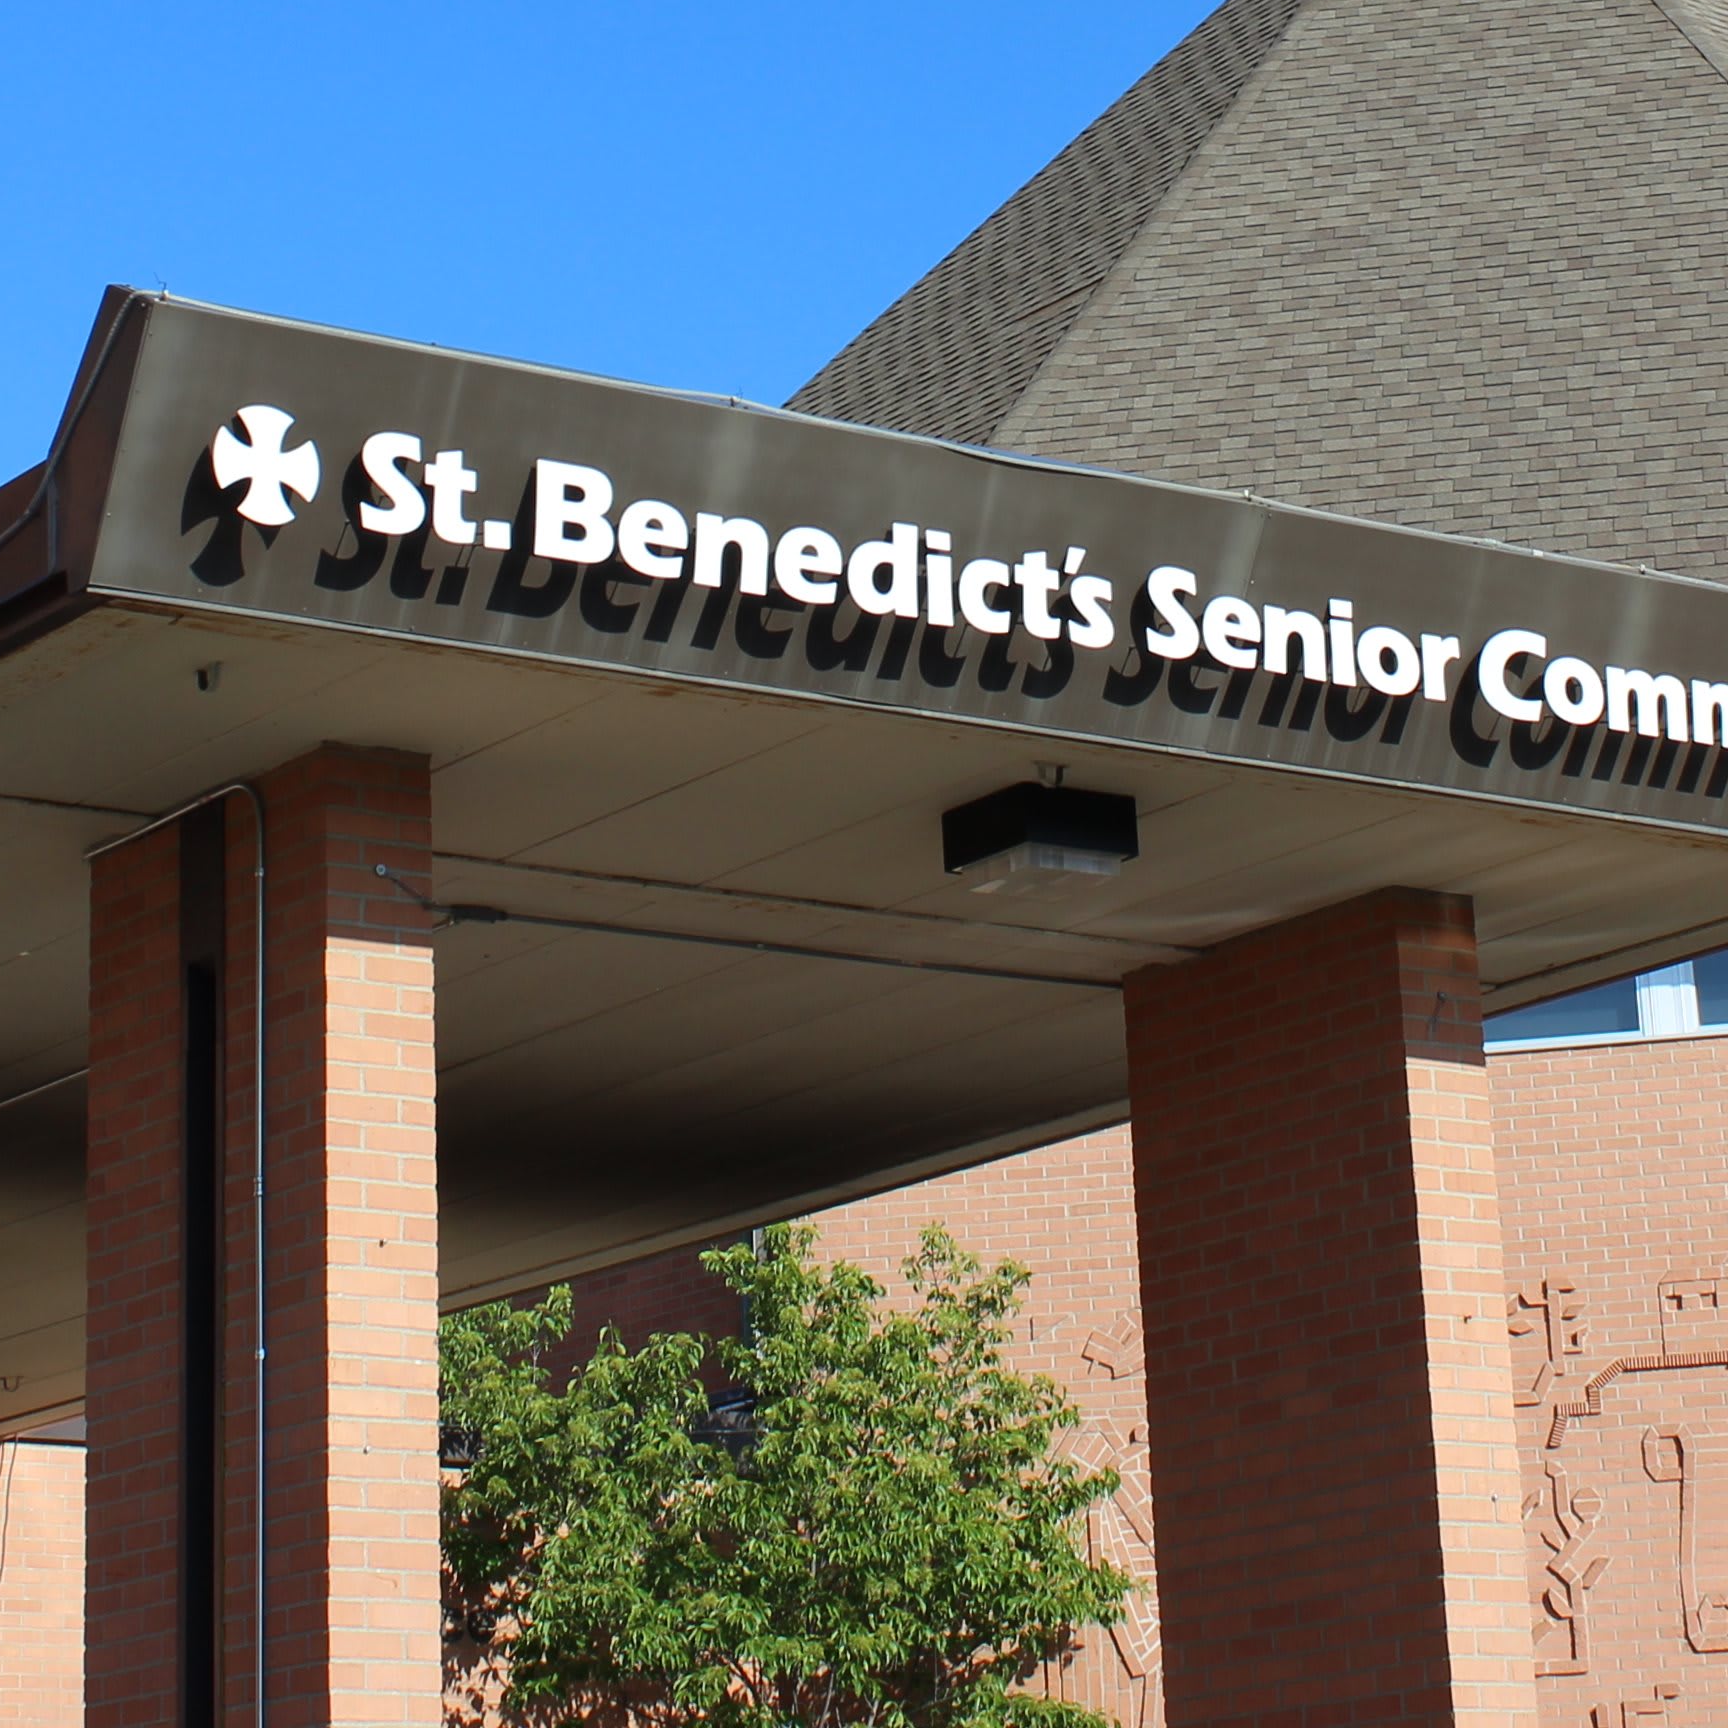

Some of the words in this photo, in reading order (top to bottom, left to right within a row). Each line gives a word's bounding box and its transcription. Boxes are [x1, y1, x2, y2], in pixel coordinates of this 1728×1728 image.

[359, 432, 511, 551] St.
[533, 459, 1114, 649] Benedict's
[1146, 566, 1460, 703] Senior
